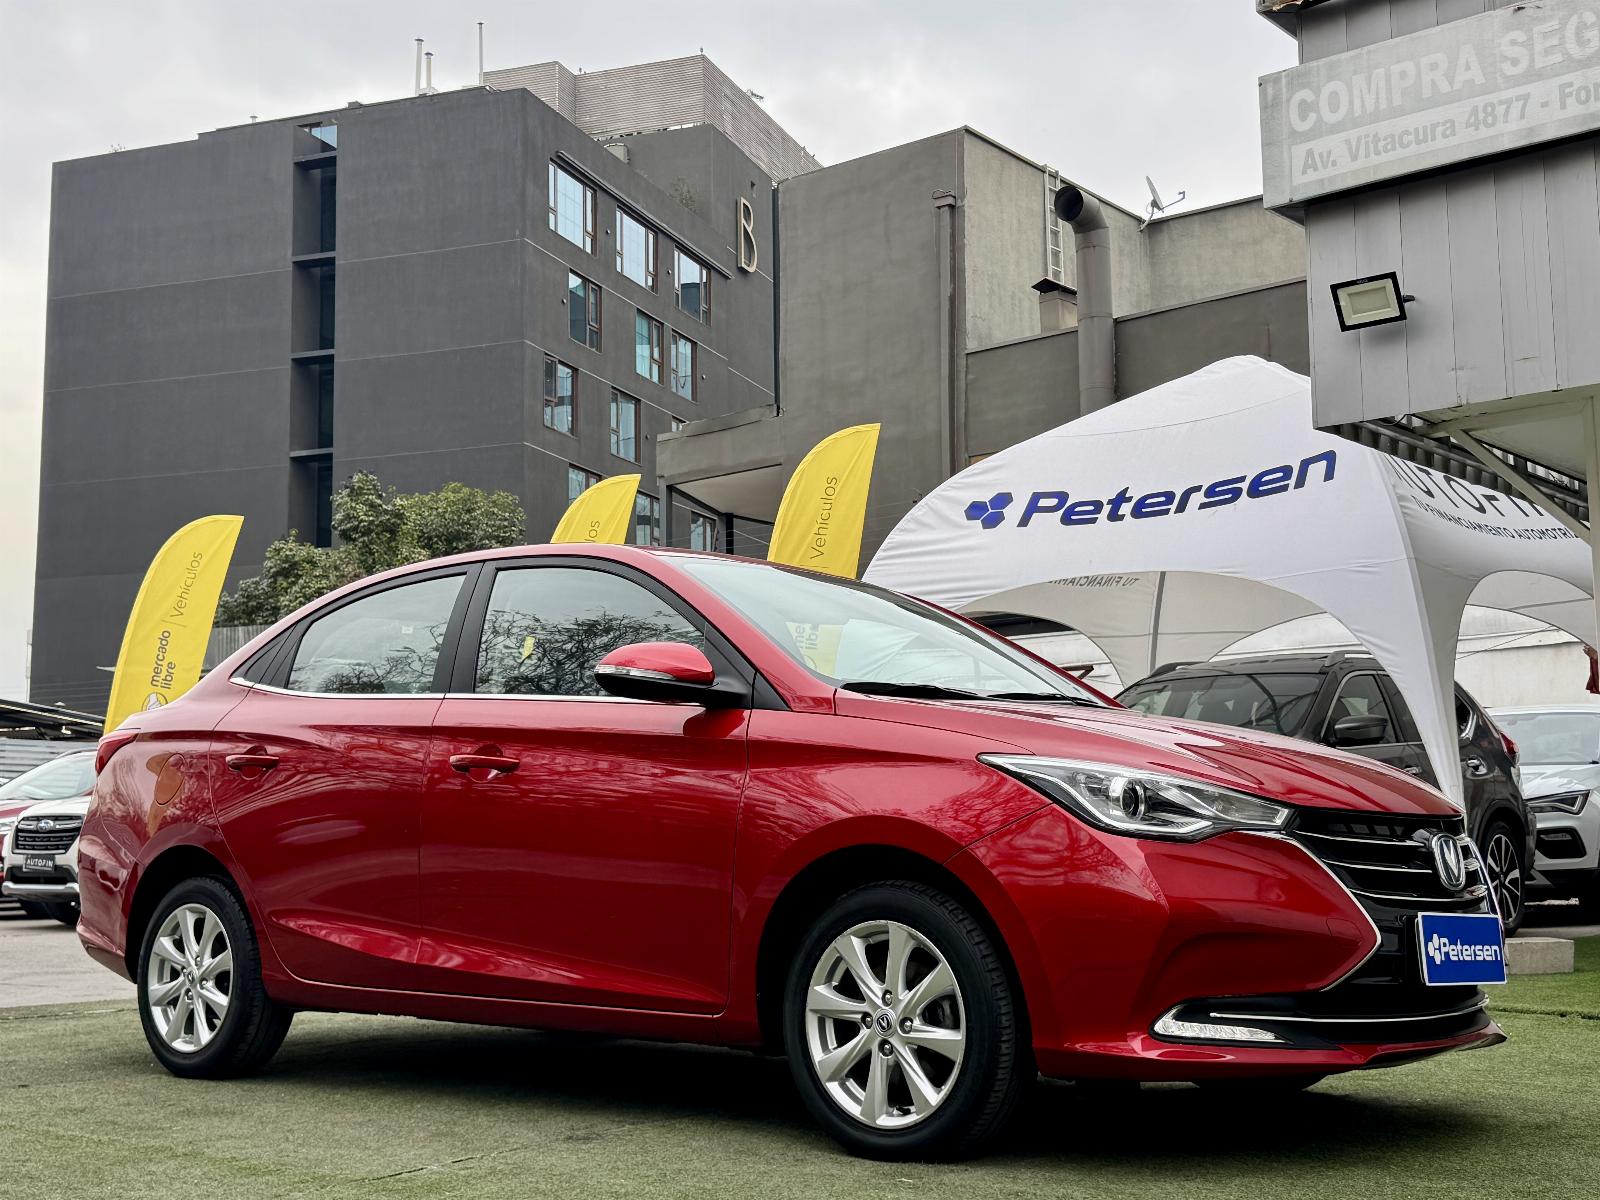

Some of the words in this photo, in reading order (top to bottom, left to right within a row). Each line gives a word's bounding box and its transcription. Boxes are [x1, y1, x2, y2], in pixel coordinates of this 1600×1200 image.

[1289, 44, 1486, 132] COMPRA
[1301, 147, 1337, 175] Av.
[1344, 115, 1456, 162] Vitacura
[1465, 93, 1531, 132] 4877
[736, 197, 757, 272] B
[810, 475, 837, 560] Vehículos
[1016, 450, 1336, 528] Petersen
[170, 551, 203, 617] Vehículos
[150, 630, 171, 687] mercado
[160, 661, 176, 689] libre
[1440, 937, 1500, 961] Petersen
